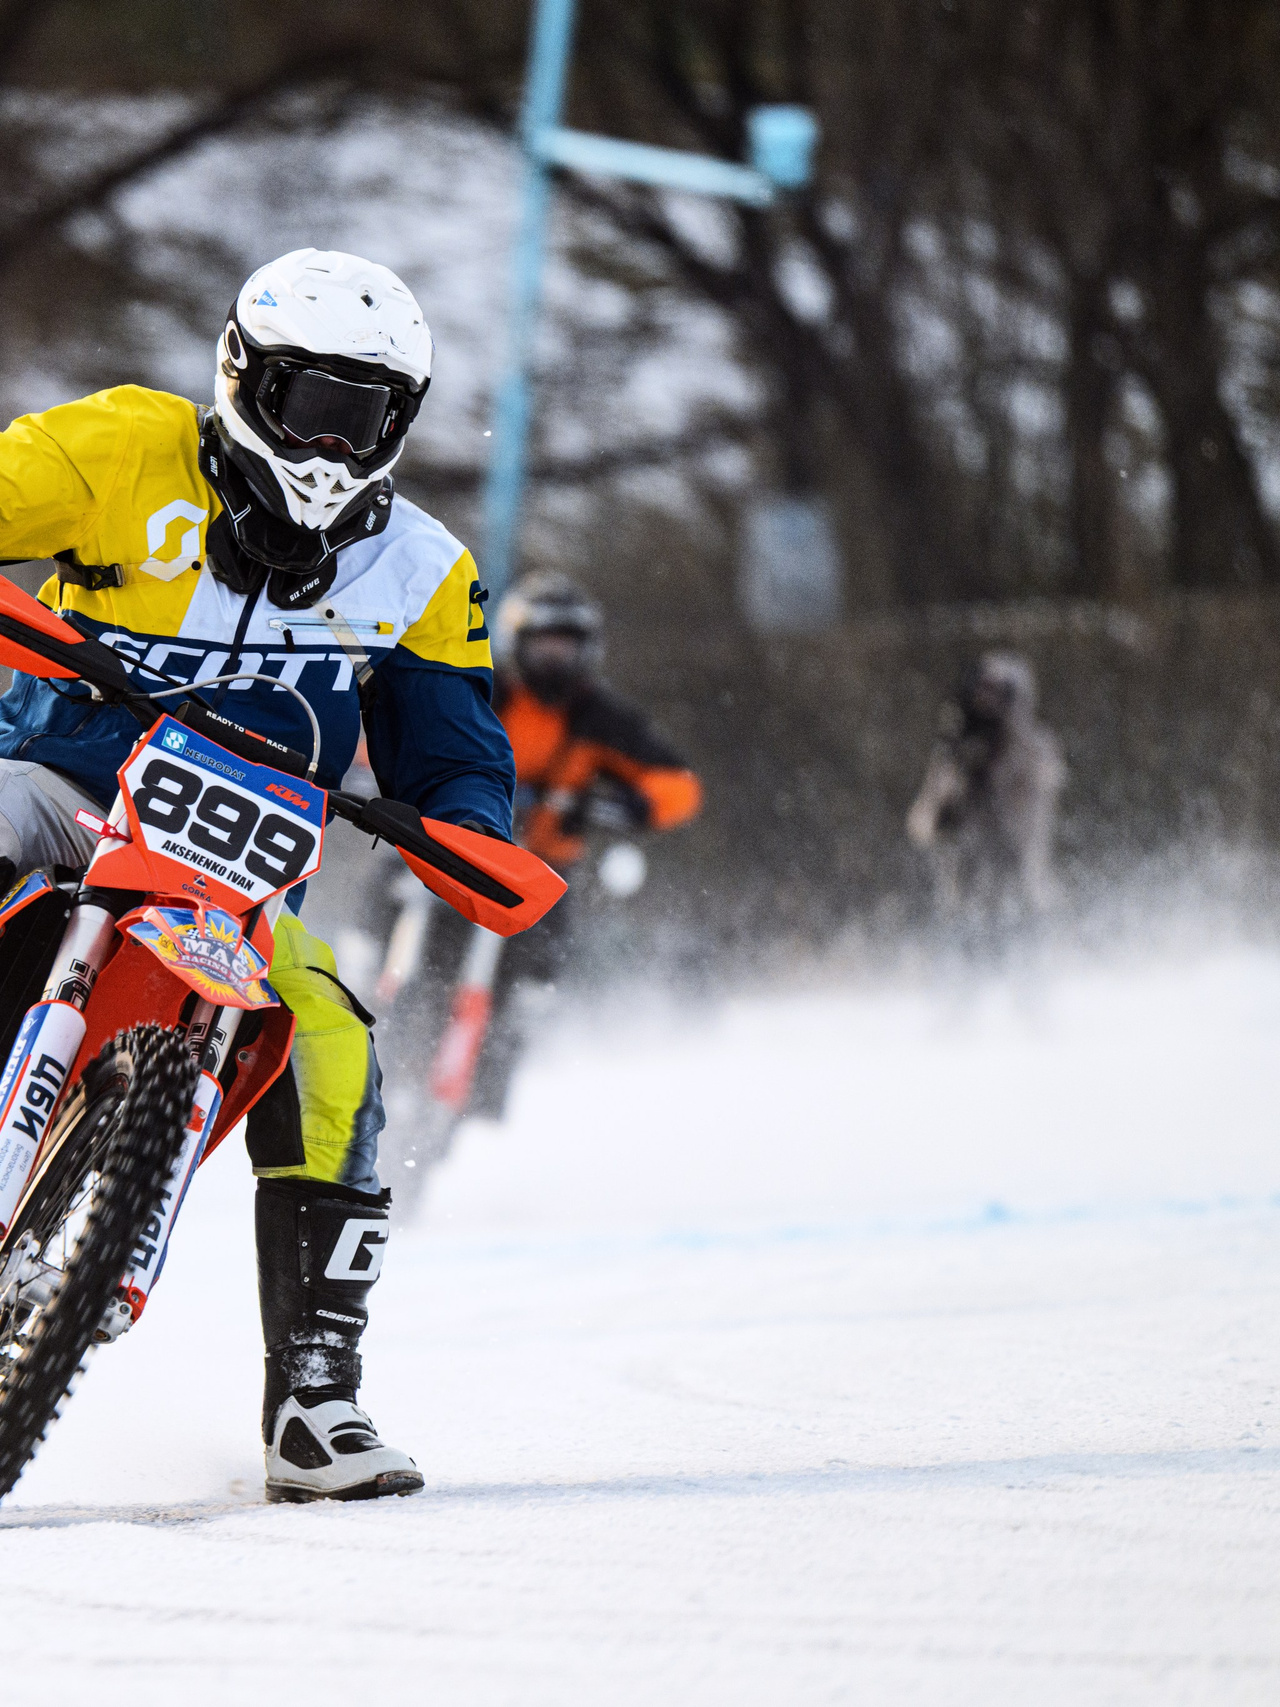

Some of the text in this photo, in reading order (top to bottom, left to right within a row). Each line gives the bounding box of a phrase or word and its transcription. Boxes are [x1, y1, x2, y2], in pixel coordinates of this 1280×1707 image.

[98, 631, 372, 692] SCOTT
[206, 710, 289, 753] READY TO RACE
[184, 747, 246, 782] NEURODAT
[265, 783, 311, 811] KTM
[132, 758, 316, 890] 899
[160, 839, 256, 892] AKSENENKO IVAN
[181, 883, 212, 902] GORKA
[182, 954, 228, 975] RACING
[183, 937, 251, 978] MAG
[12, 1053, 67, 1143] ЦБИ
[316, 1309, 366, 1326] GAERNE
